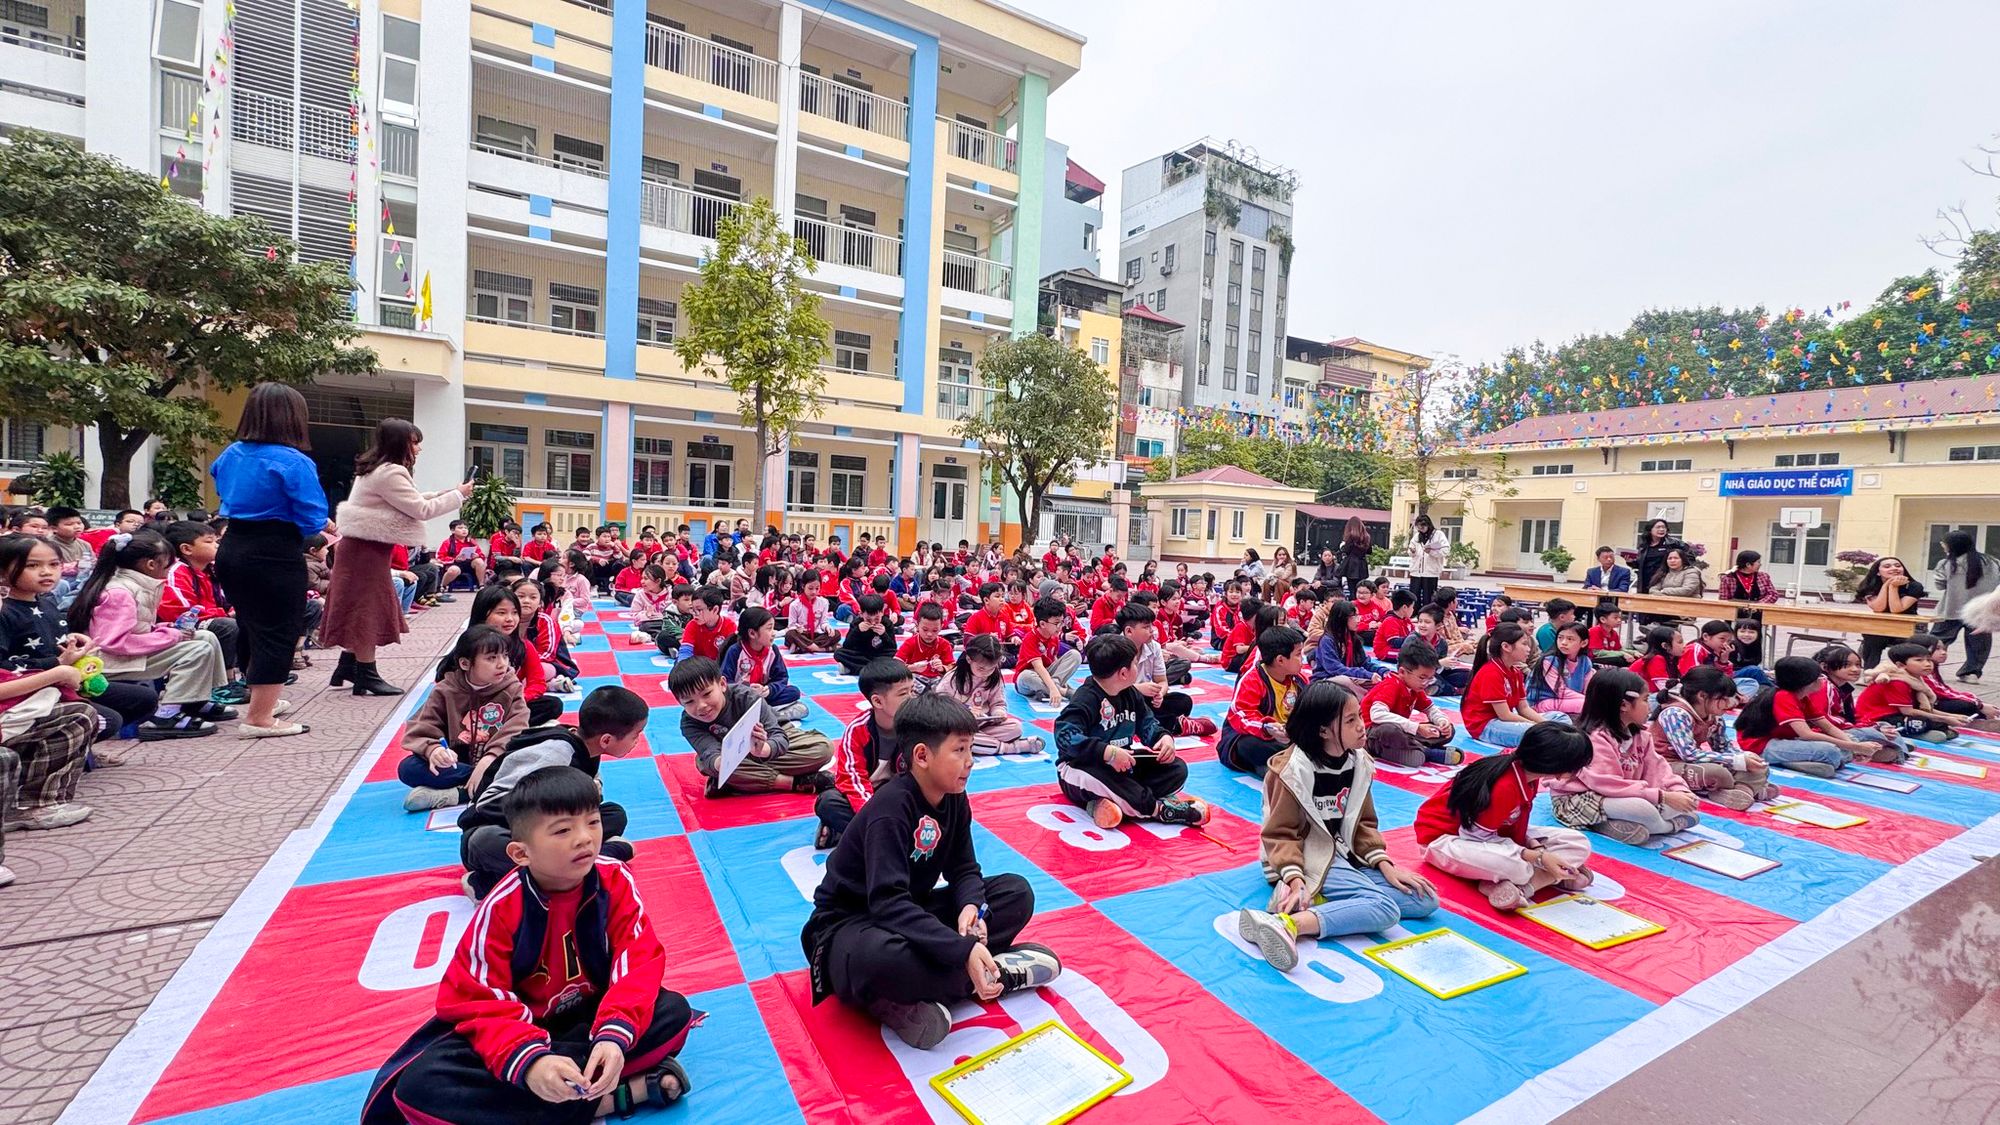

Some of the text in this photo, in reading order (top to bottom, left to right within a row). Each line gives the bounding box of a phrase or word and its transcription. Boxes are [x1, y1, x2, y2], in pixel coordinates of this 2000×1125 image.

[1725, 472, 1849, 492] NHÀ GIÁO DỤC THỂ CHẤT
[482, 709, 500, 720] 030
[920, 829, 937, 841] 009
